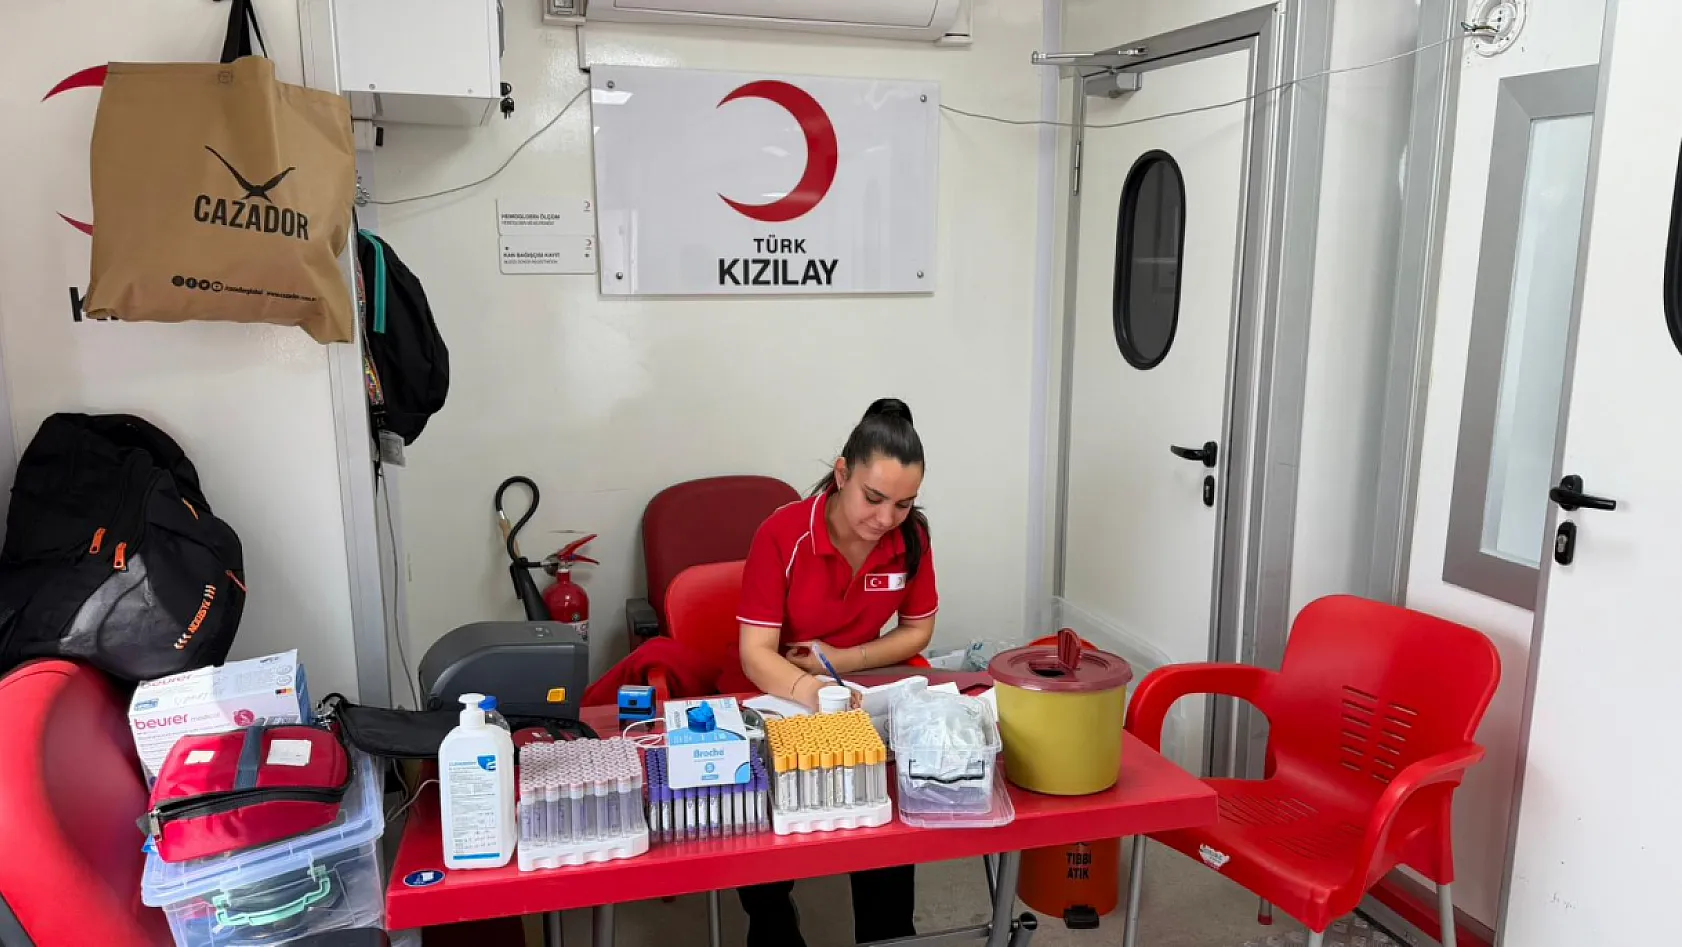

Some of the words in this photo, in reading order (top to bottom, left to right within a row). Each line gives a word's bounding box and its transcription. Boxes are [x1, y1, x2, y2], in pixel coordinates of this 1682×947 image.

[194, 194, 309, 241] CAZADOR
[753, 234, 806, 254] TÜRK
[718, 257, 839, 286] KIZILAY
[134, 713, 188, 730] beurer
[1067, 866, 1089, 879] ATIK
